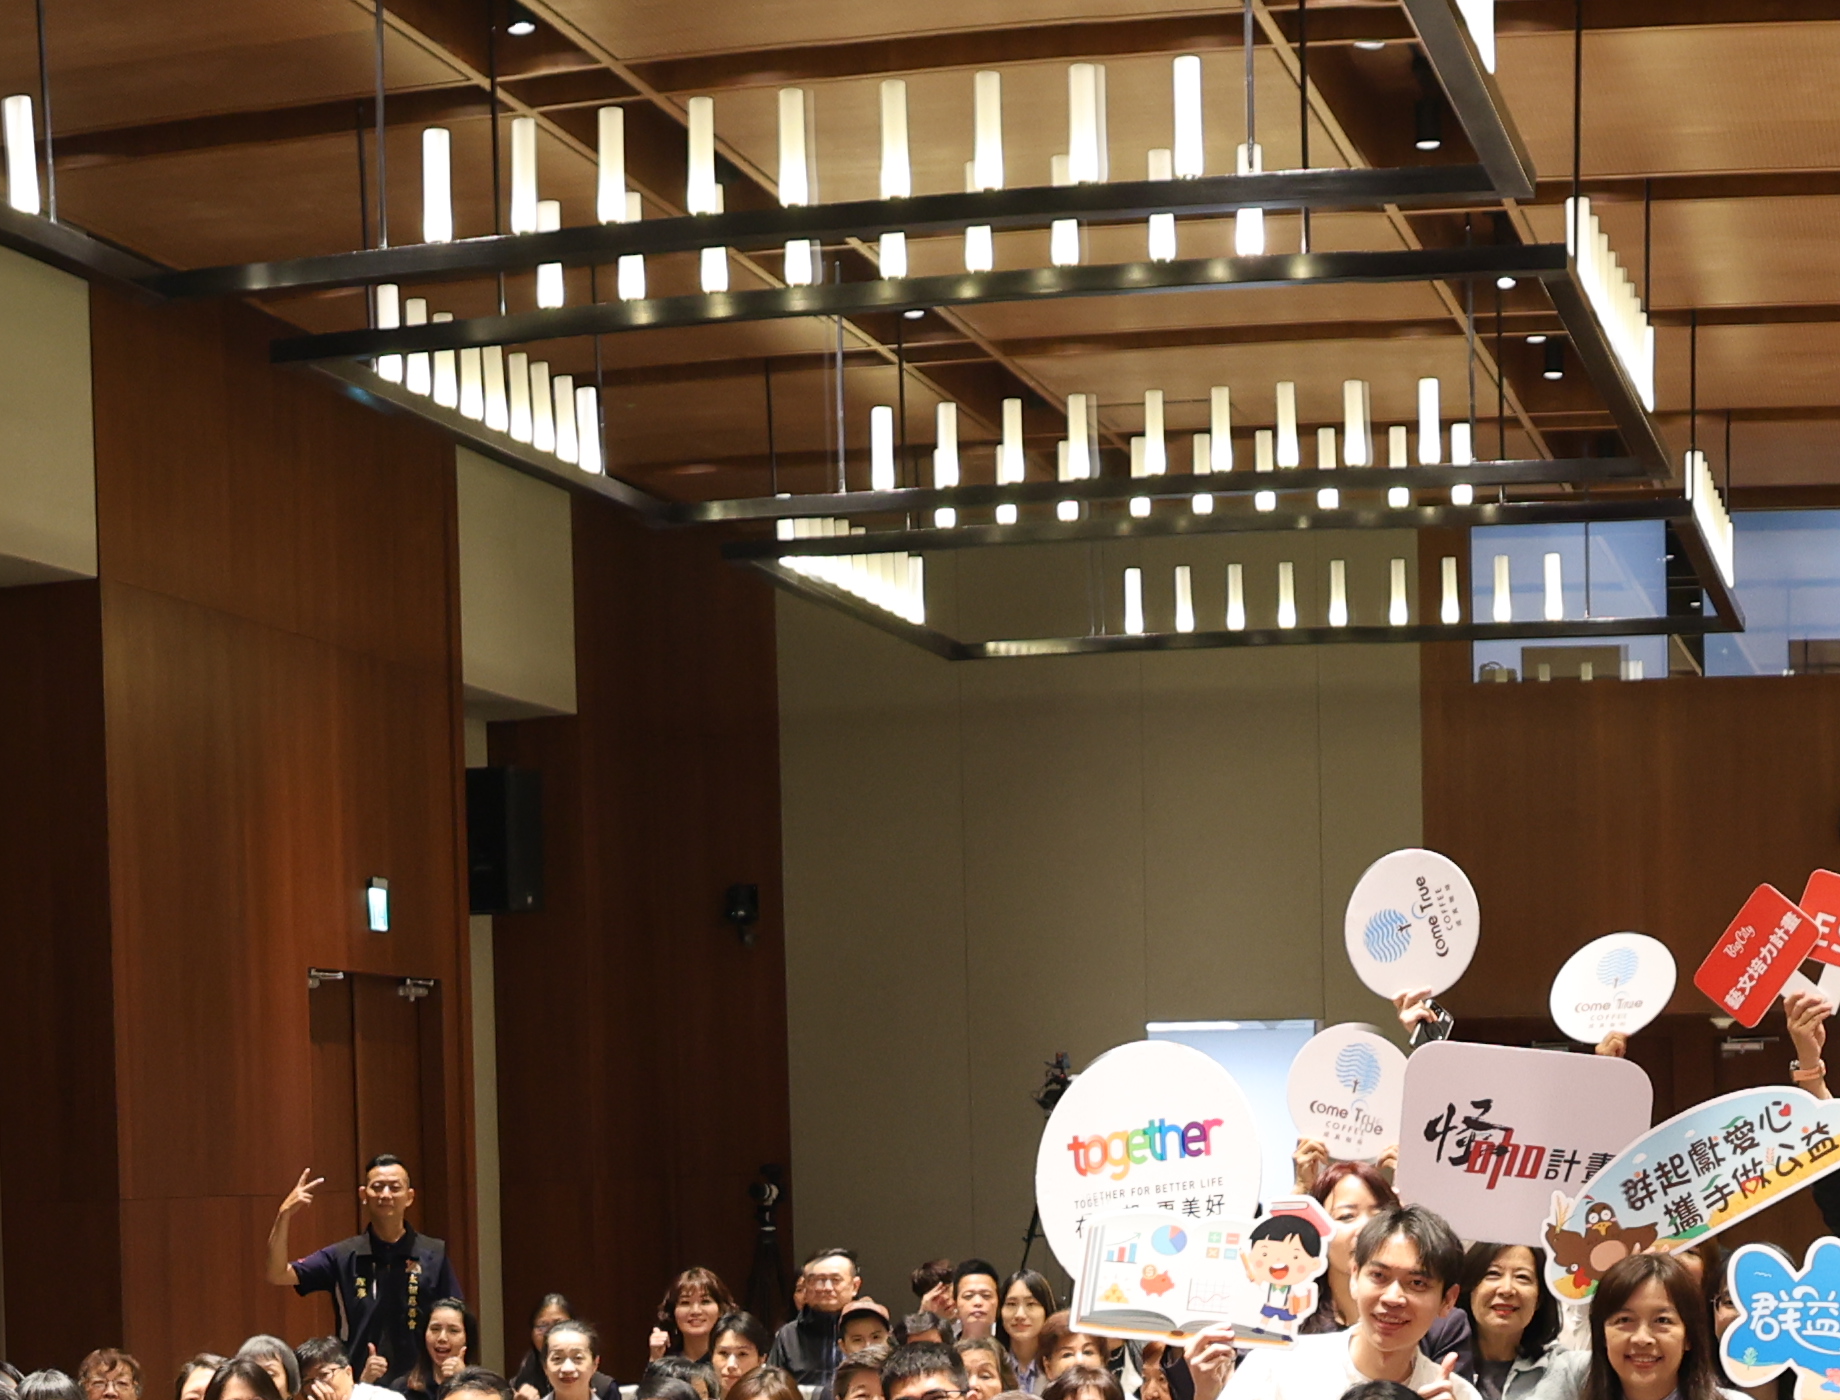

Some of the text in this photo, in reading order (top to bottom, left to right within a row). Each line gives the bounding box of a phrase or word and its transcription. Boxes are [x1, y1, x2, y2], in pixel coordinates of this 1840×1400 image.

[1724, 910, 1803, 1011] 藝文培力計畫
[1067, 1118, 1224, 1181] together
[1309, 1100, 1348, 1119] Come
[1131, 1185, 1150, 1197] FOR
[1155, 1181, 1195, 1194] BETTER
[1200, 1176, 1223, 1188] LIFE
[1621, 1100, 1792, 1212] 群起獻愛心
[1662, 1120, 1840, 1237] 攜手做公益
